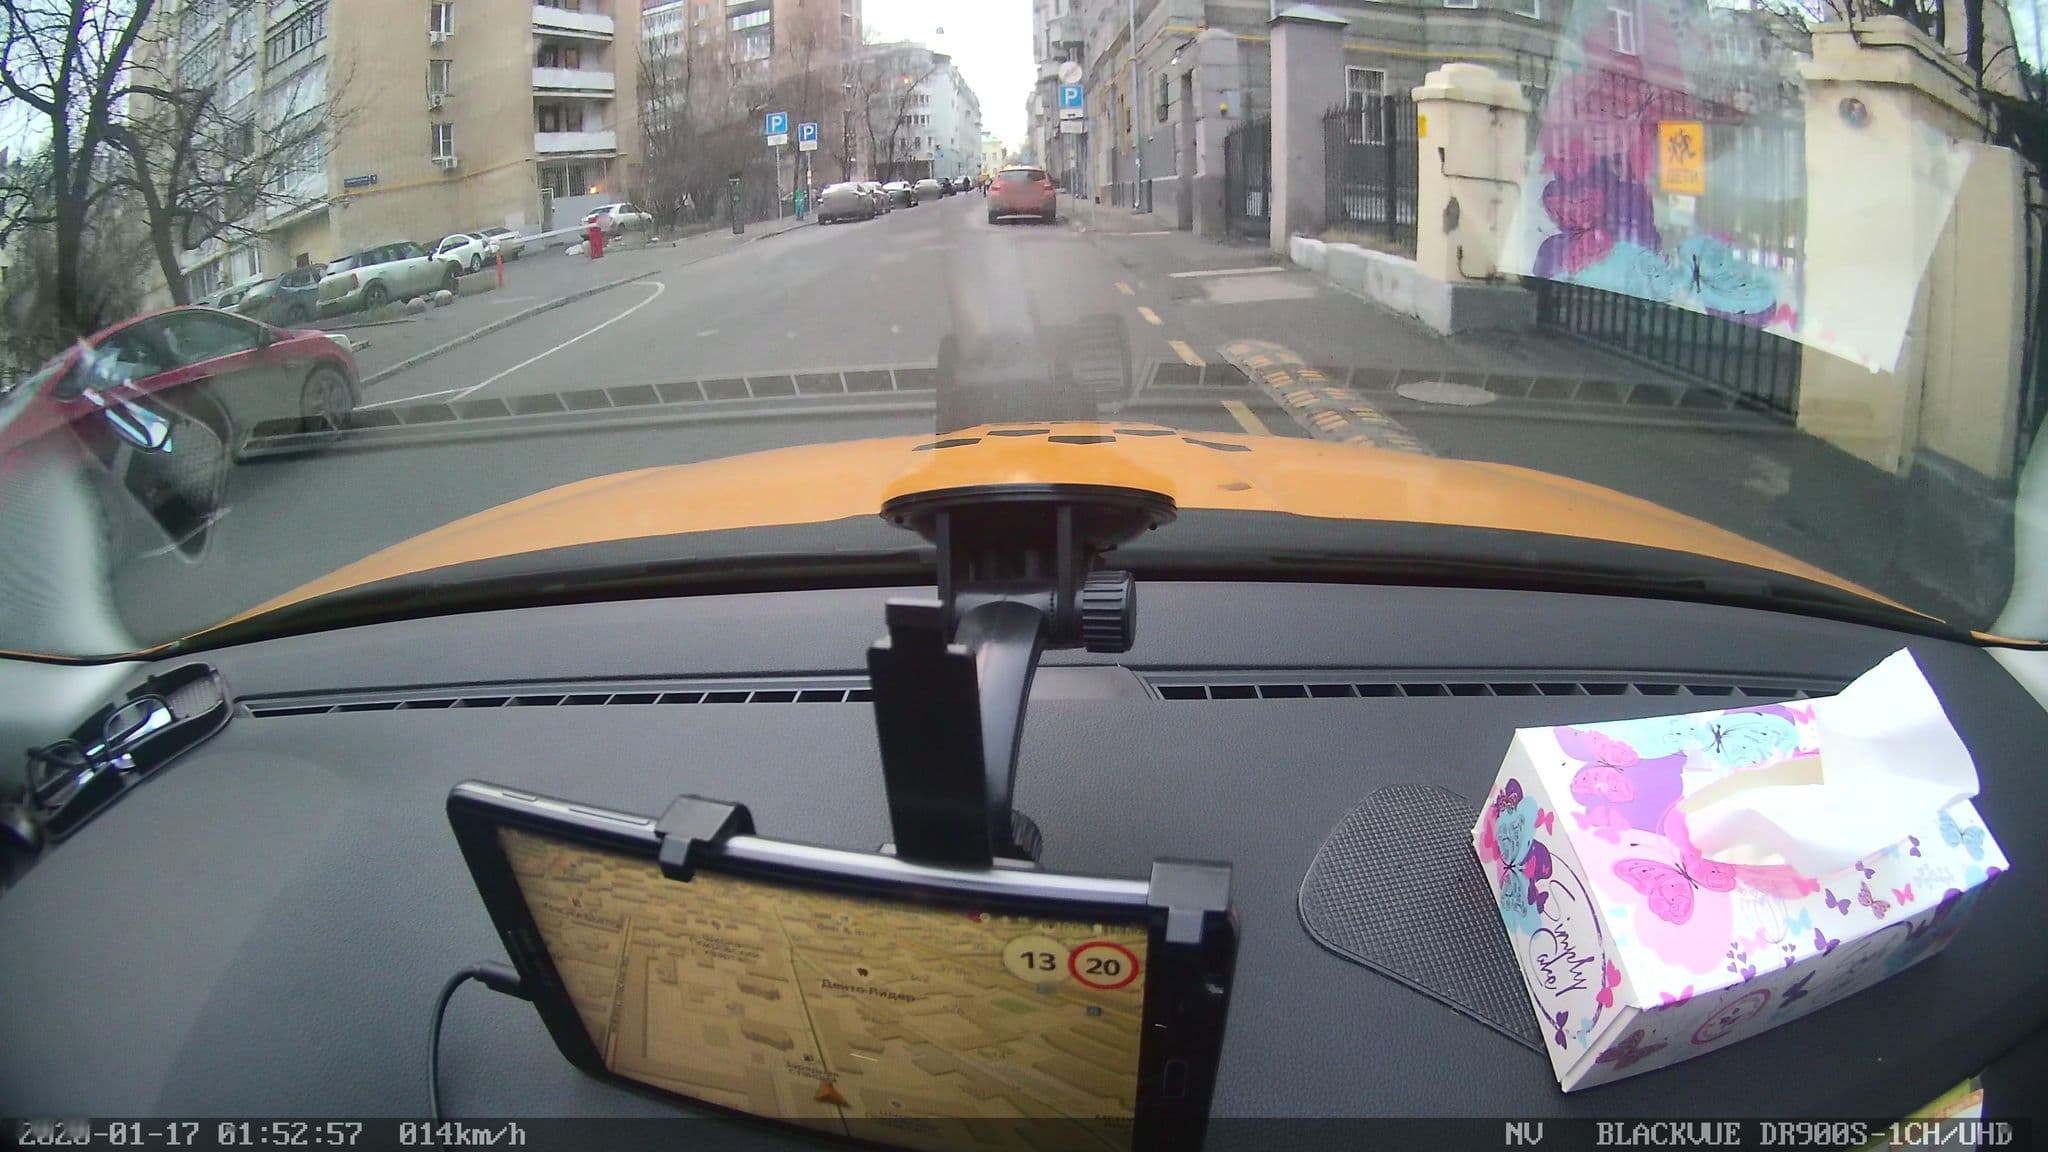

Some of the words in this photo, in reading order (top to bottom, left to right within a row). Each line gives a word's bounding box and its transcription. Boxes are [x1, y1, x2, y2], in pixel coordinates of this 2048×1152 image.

[1064, 87, 1078, 105] P
[771, 115, 783, 132] P
[803, 126, 814, 140] P
[1020, 951, 1057, 972] 13
[1085, 957, 1121, 977] 20
